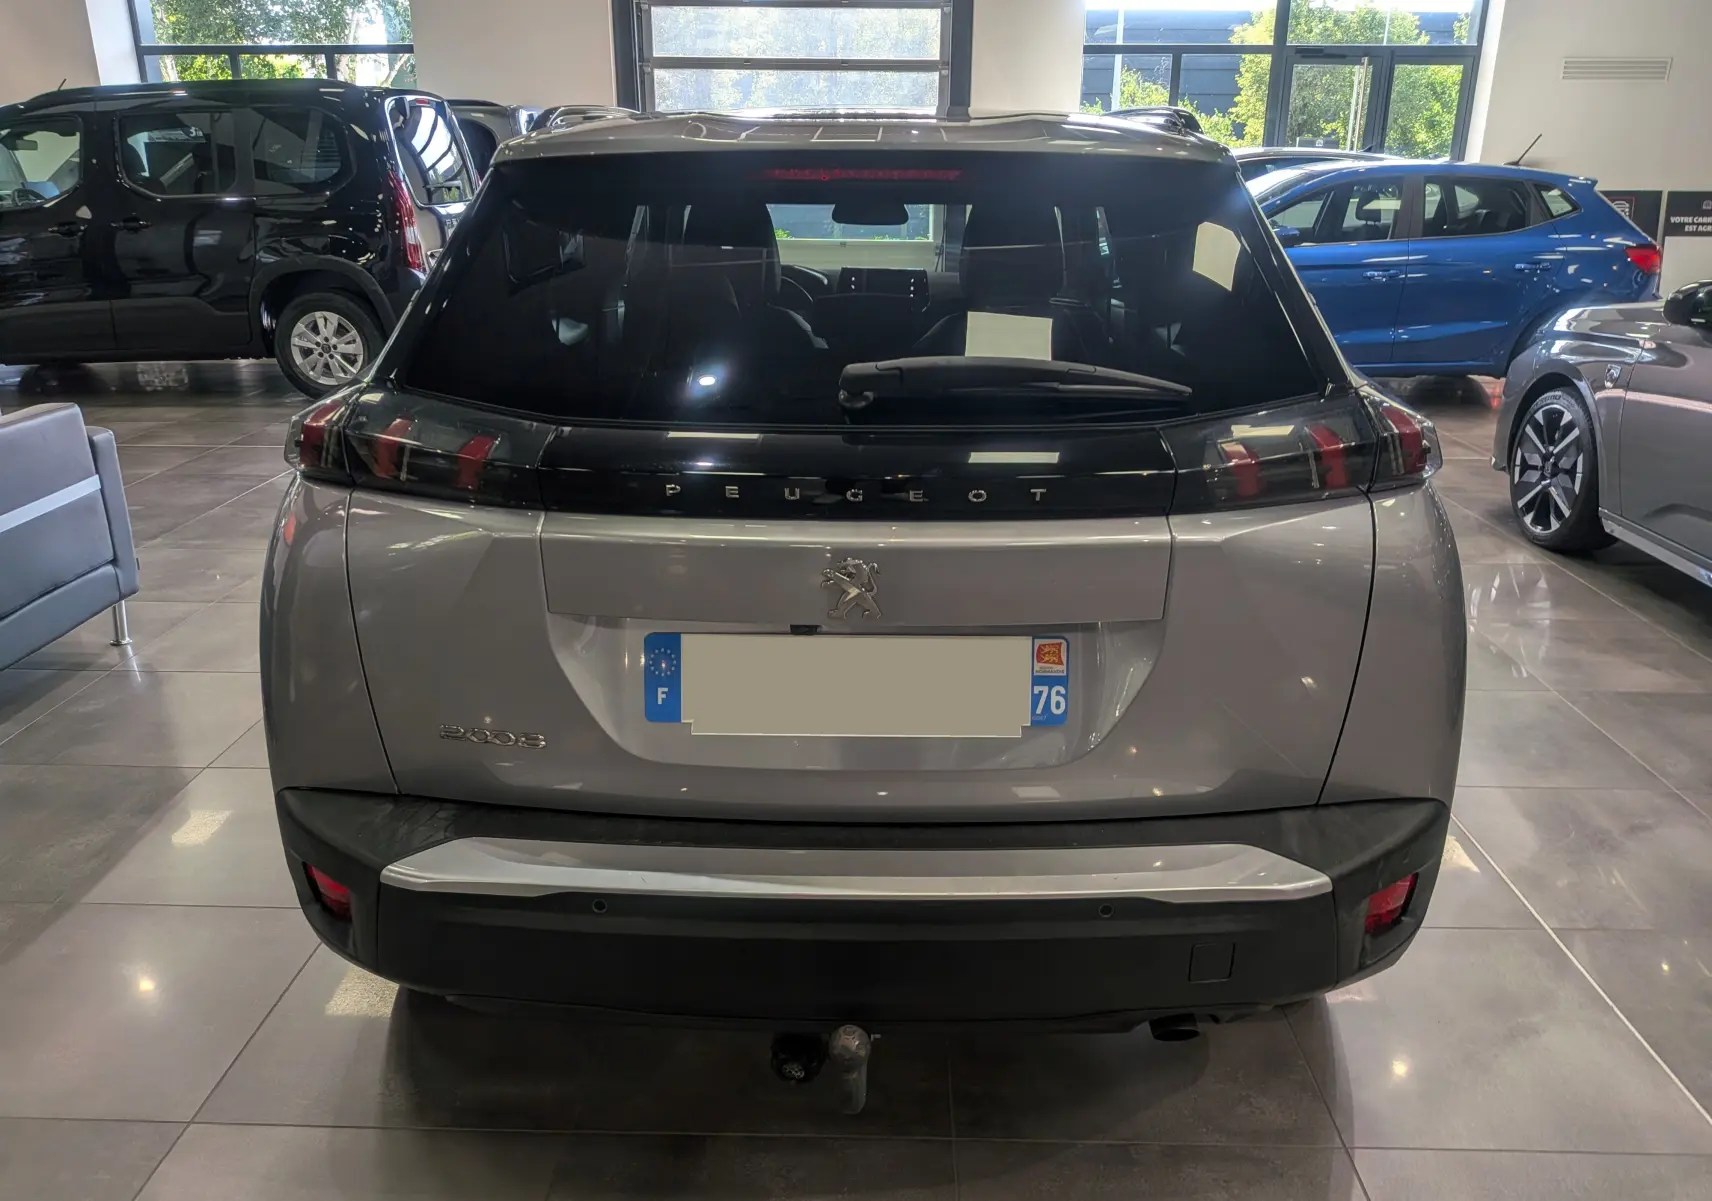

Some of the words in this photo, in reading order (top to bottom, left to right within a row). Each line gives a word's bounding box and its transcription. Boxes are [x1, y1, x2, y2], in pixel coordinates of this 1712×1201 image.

[666, 484, 1046, 502] PEUGEOT
[657, 687, 669, 705] F
[1033, 685, 1066, 715] 76
[440, 724, 547, 749] 2008
